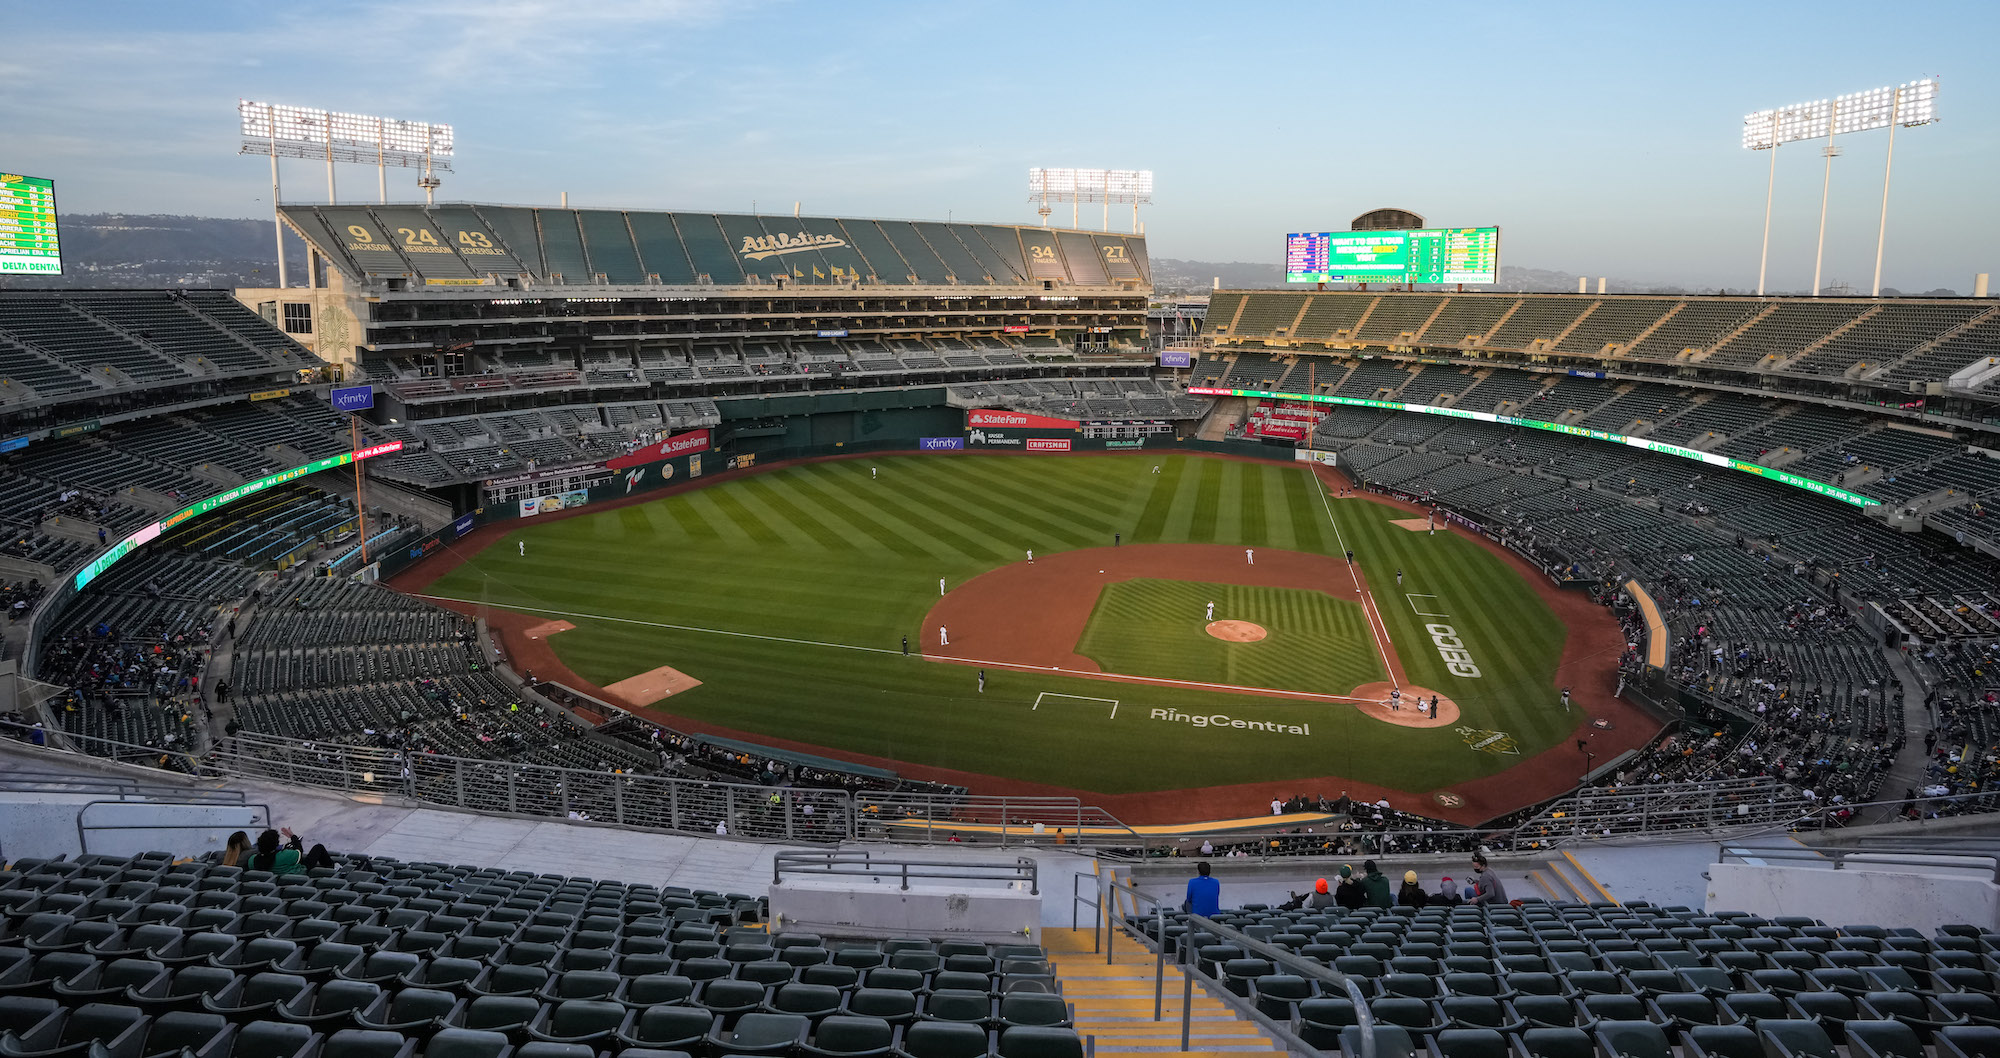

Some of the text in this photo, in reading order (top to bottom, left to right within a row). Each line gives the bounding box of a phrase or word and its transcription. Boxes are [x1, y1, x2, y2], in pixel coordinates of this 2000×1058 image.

[348, 225, 372, 243] 9
[398, 228, 438, 246] 24
[458, 230, 493, 248] 43
[349, 243, 392, 252] JACKSON
[402, 245, 453, 254] HENDERSON
[460, 247, 506, 256] ECKERSLEY
[740, 232, 846, 259] Athletics
[1031, 246, 1054, 258] 34
[1103, 246, 1124, 258] 27
[2, 262, 60, 271] DELTA DENTAL
[1165, 355, 1186, 363] xfinity
[338, 393, 368, 406] xfinity
[927, 439, 957, 449] xfinity
[737, 453, 755, 462] STREAM
[1658, 445, 1703, 461] DELTA DENTAL
[1736, 463, 1763, 475] SANCHEZ
[101, 538, 138, 571] DELTA DENTAL
[1425, 623, 1482, 678] GEICO
[1150, 708, 1310, 736] RingCentral
[1455, 726, 1477, 736] 24
[1439, 795, 1458, 806] A's
